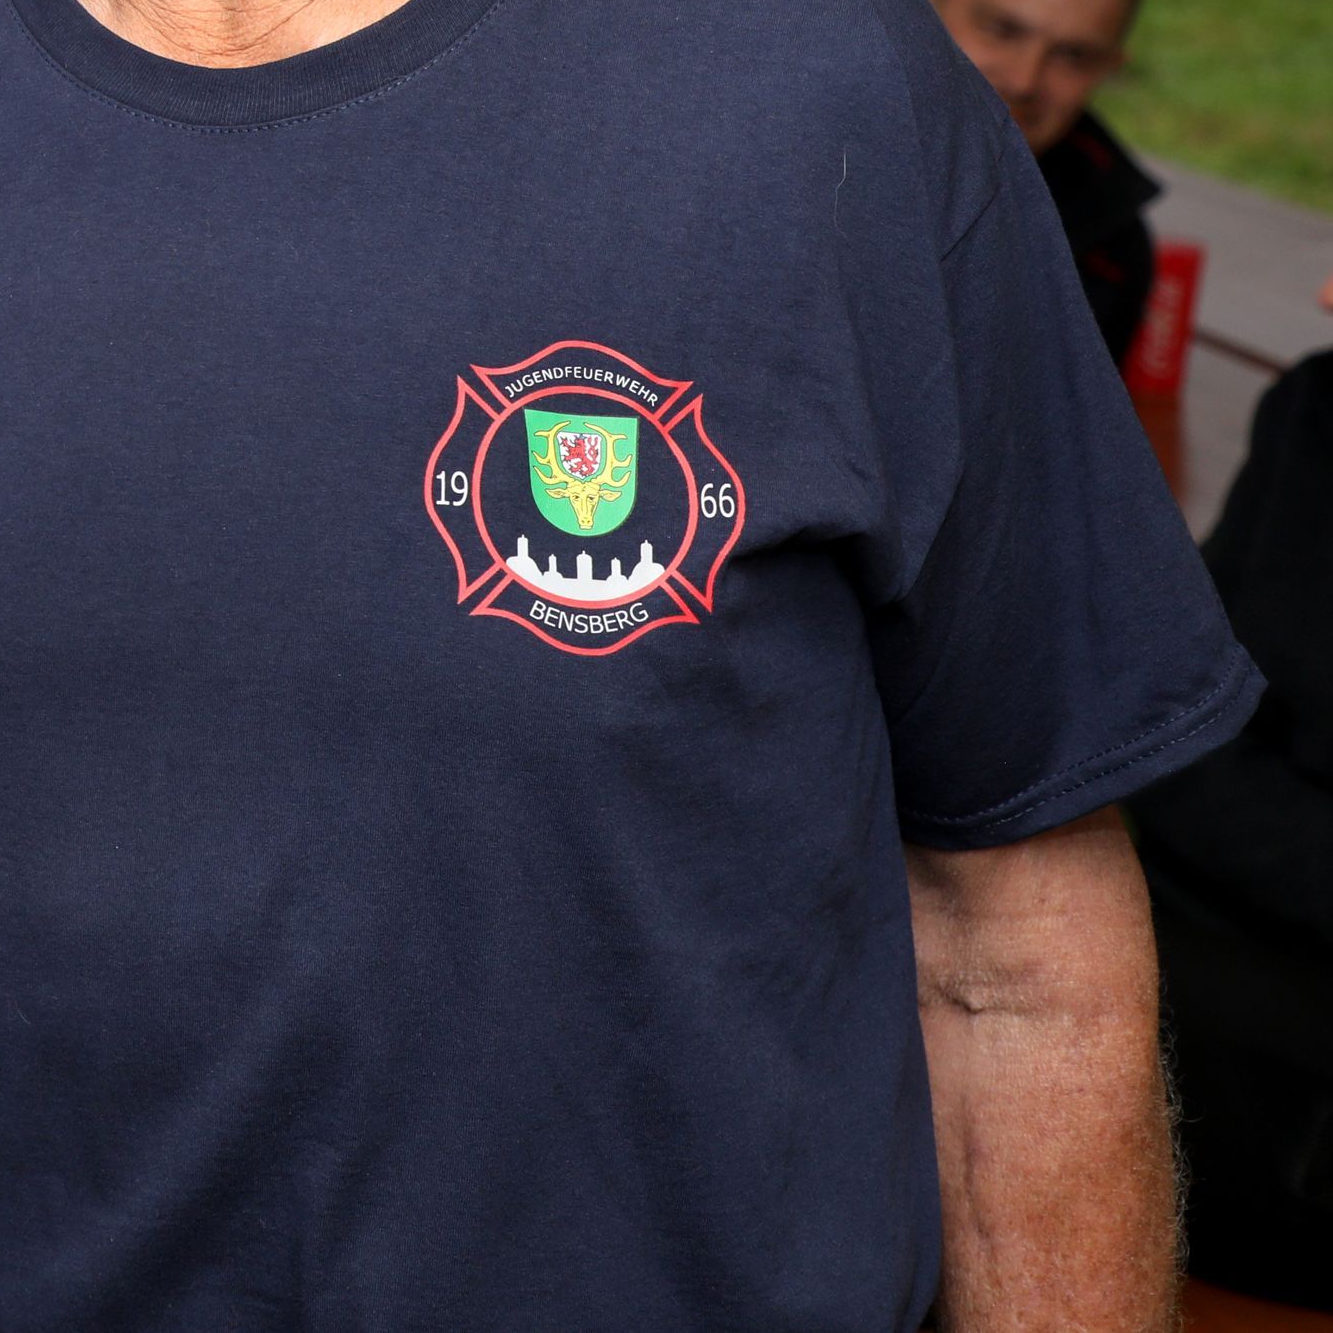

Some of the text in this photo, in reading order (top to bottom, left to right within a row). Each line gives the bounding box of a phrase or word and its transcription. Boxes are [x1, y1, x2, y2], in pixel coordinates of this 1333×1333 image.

[504, 366, 659, 407] JUGENDFEUERWEHR
[435, 470, 469, 507] 19
[700, 483, 736, 518] 66
[529, 600, 649, 634] BENSBERG
